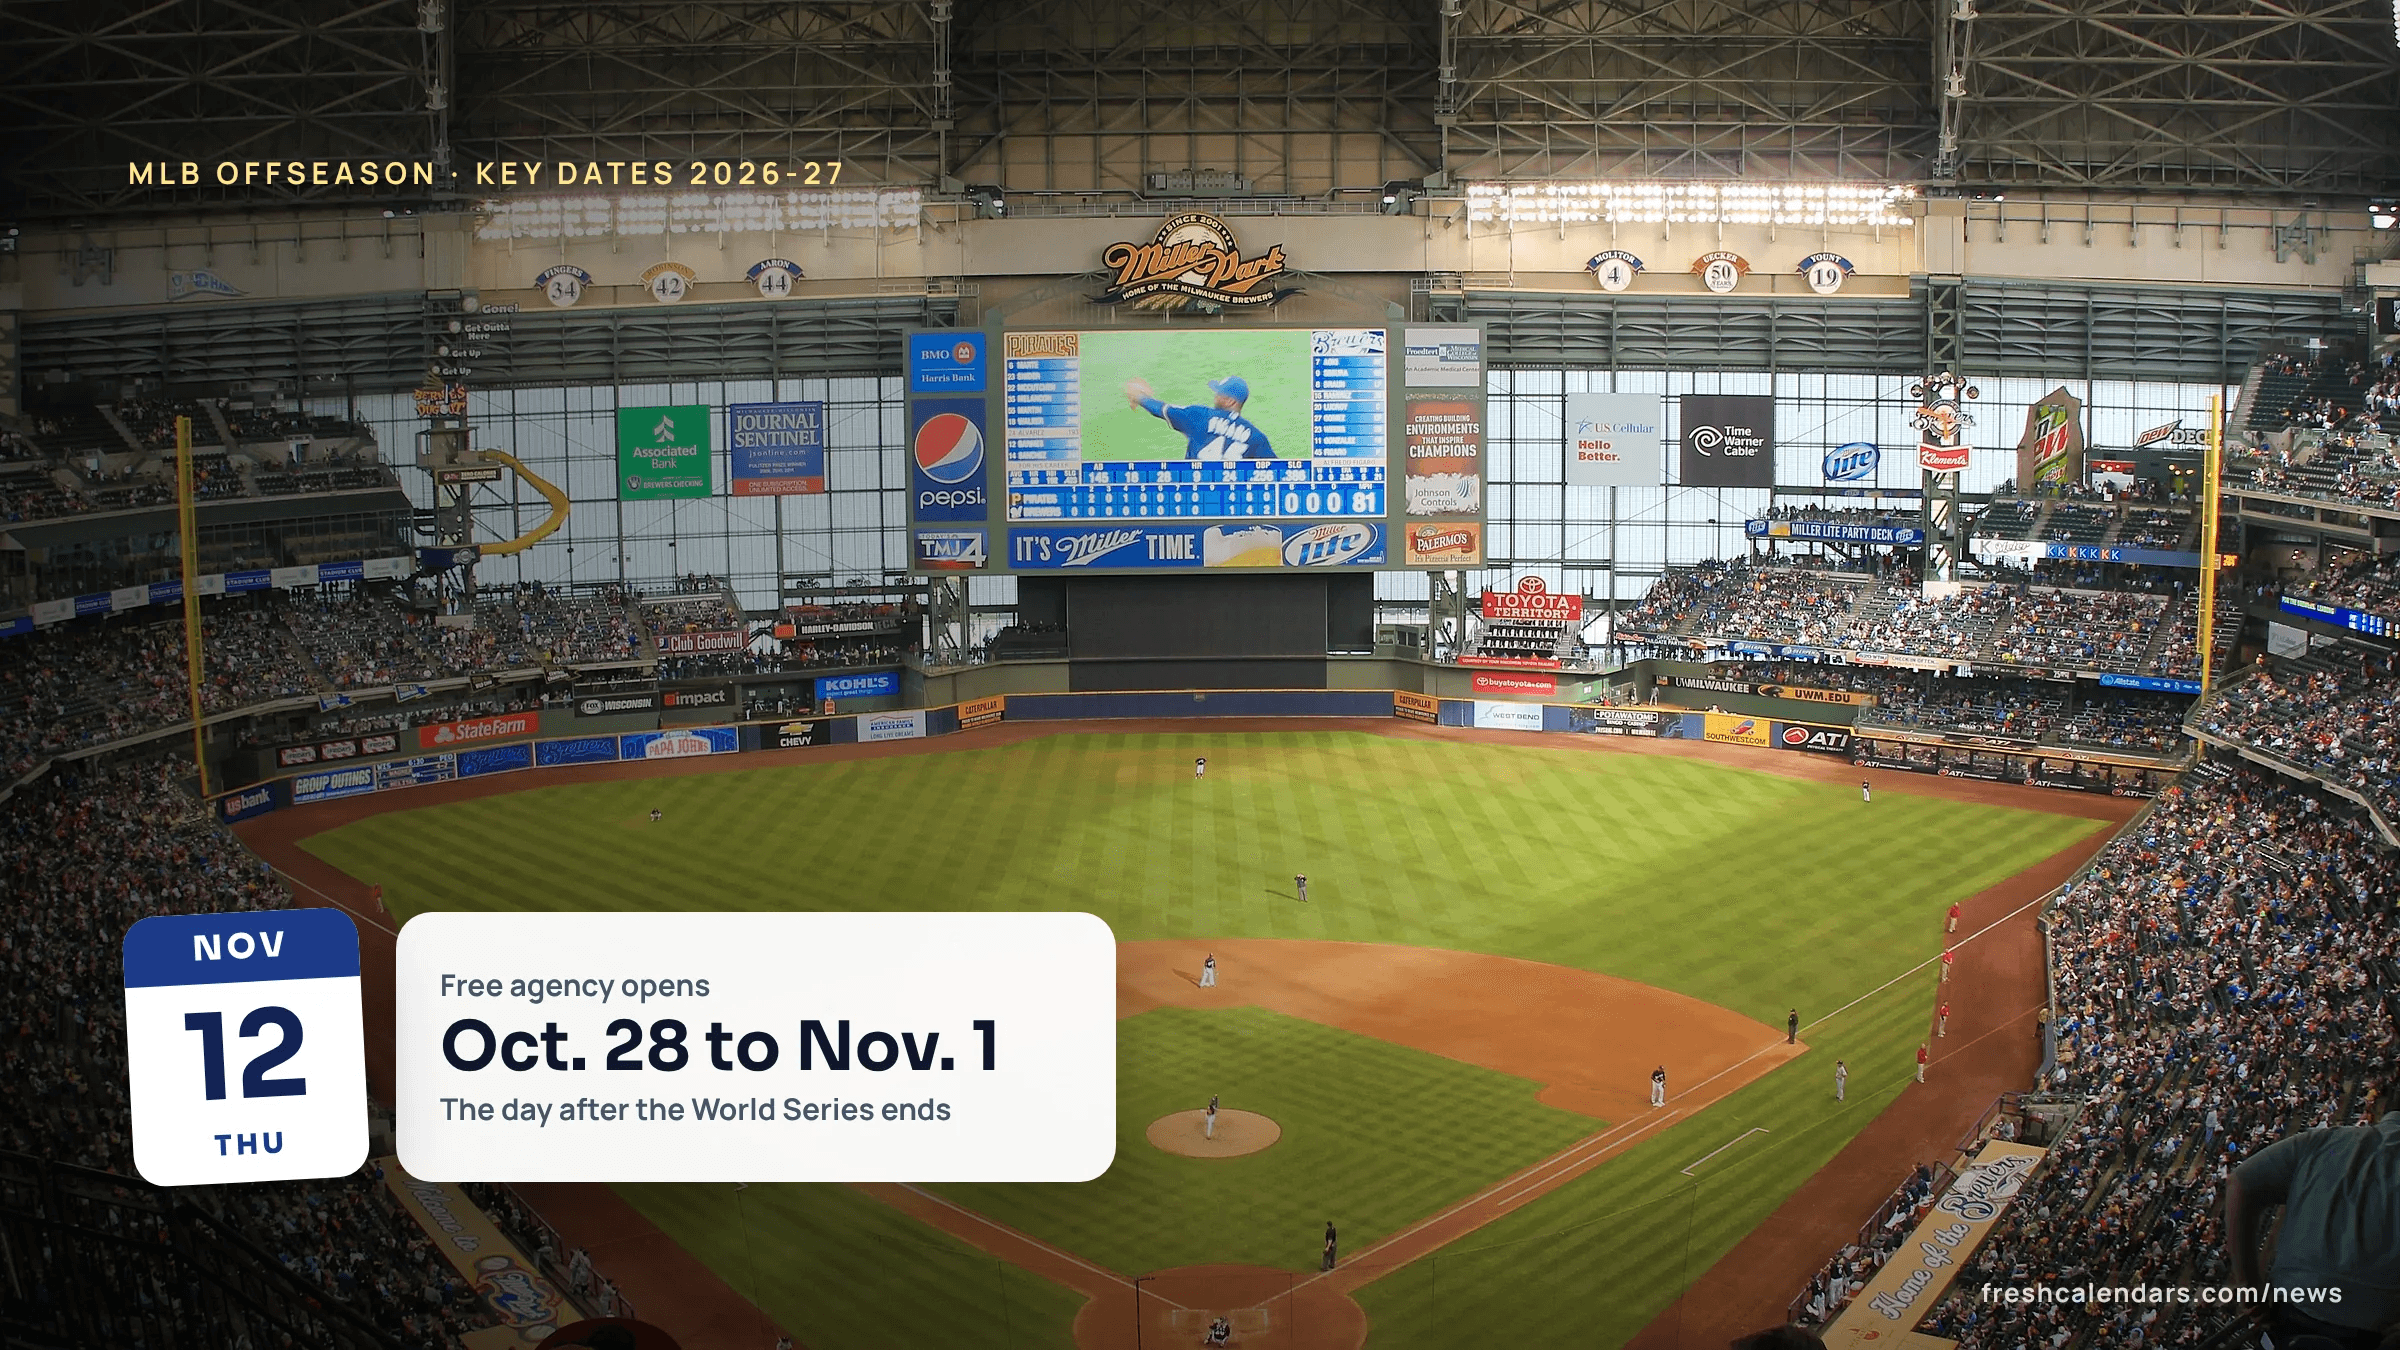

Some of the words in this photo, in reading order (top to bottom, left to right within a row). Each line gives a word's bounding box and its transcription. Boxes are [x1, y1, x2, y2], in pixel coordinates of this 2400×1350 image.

[1166, 215, 1198, 231] SINCE
[1200, 216, 1222, 231] 2001
[760, 259, 791, 270] AARON
[1104, 241, 1217, 286] Miller
[1195, 244, 1286, 288] Park
[1595, 251, 1636, 265] MOLITOR
[1703, 252, 1738, 263] UECKER
[1810, 254, 1842, 263] YOUNT
[545, 266, 584, 279] FINGERS
[1607, 267, 1620, 284] 4
[1711, 265, 1732, 280] 50
[1814, 268, 1838, 287] 19
[552, 281, 577, 298] 34
[656, 278, 680, 295] 42
[762, 275, 788, 293] 44
[1122, 286, 1147, 300] HOME
[1148, 283, 1160, 292] OF
[1162, 283, 1179, 291] THE
[1181, 284, 1231, 304] MILWAUKEE
[1232, 292, 1274, 304] BREWERS
[482, 304, 520, 313] Gone!
[465, 324, 481, 332] Get
[484, 323, 510, 332] Outta
[468, 332, 491, 340] Here
[1008, 334, 1077, 357] PIRATES
[452, 349, 467, 358] Get
[469, 349, 481, 358] Up
[921, 350, 949, 360] BMO
[442, 367, 458, 375] Get
[460, 367, 472, 376] Up
[922, 374, 950, 382] Harris
[952, 373, 975, 382] Bank
[735, 413, 820, 432] JOURNAL
[1406, 423, 1480, 435] ENVIRONMENTS
[1613, 423, 1654, 433] Cellular
[1724, 426, 1751, 436] Time
[734, 431, 820, 448] SENTINEL
[1422, 436, 1438, 444] THAT
[1439, 436, 1464, 444] INSPIRE
[1578, 440, 1611, 449] Hello
[1724, 436, 1764, 446] Warner
[633, 445, 697, 458] Associated
[1409, 444, 1477, 458] CHAMPIONS
[1578, 452, 1620, 461] Better.
[1723, 447, 1755, 457] Cable
[1921, 450, 1968, 466] Klement's
[651, 458, 678, 468] Bank
[1831, 450, 1873, 478] Lite
[920, 486, 981, 509] pepsi
[1415, 489, 1450, 497] Johnson
[1285, 492, 1299, 513] 0
[1305, 492, 1320, 513] 0
[1327, 492, 1342, 513] 0
[1352, 491, 1376, 513] 81
[1309, 525, 1346, 541] Miller
[1792, 523, 1821, 536] MILLER
[1822, 525, 1841, 537] LITE
[1842, 527, 1869, 539] PARTY
[1871, 528, 1893, 540] DECK
[1016, 536, 1051, 561] IT'S
[1056, 529, 1143, 564] Miller
[1417, 533, 1467, 551] PALERMO'S
[1980, 540, 1991, 553] K
[1299, 533, 1362, 566] Lite
[1493, 594, 1570, 609] TOYOTA
[1494, 607, 1570, 619] TERRITORY
[801, 621, 874, 635] HARLEY-DAVIDSON
[670, 638, 693, 652] Club
[697, 631, 743, 650] Goodwill
[826, 677, 889, 691] KOHL'S
[1489, 678, 1552, 689] buyatoyota.com
[2114, 678, 2140, 687] Allstate
[675, 690, 725, 706] impact
[1400, 695, 1431, 708] CATERPILLAR
[1794, 689, 1850, 703] UWM.EDU
[605, 698, 652, 710] WISCONSIN
[965, 700, 997, 714] CATERPILLAR
[1516, 713, 1540, 721] BEND
[1599, 711, 1654, 721] POTAWATOMI
[456, 716, 526, 741] StateFarm
[780, 736, 812, 747] CHEVY
[1706, 732, 1766, 745] SOUTHWEST.COM
[1807, 732, 1848, 747] ATI
[1988, 738, 2011, 746] ATI
[649, 742, 673, 756] PAPA
[1864, 760, 1880, 768] ATI
[1948, 769, 1964, 777] ATI
[296, 775, 330, 794] GROUP
[330, 770, 371, 788] OUTINGS
[2034, 779, 2051, 787] ATI
[2122, 789, 2139, 797] ATI
[1937, 1155, 2040, 1221] Brewers
[1933, 1223, 1971, 1248] the
[1920, 1241, 1954, 1269] of
[1869, 1269, 1933, 1320] Home
